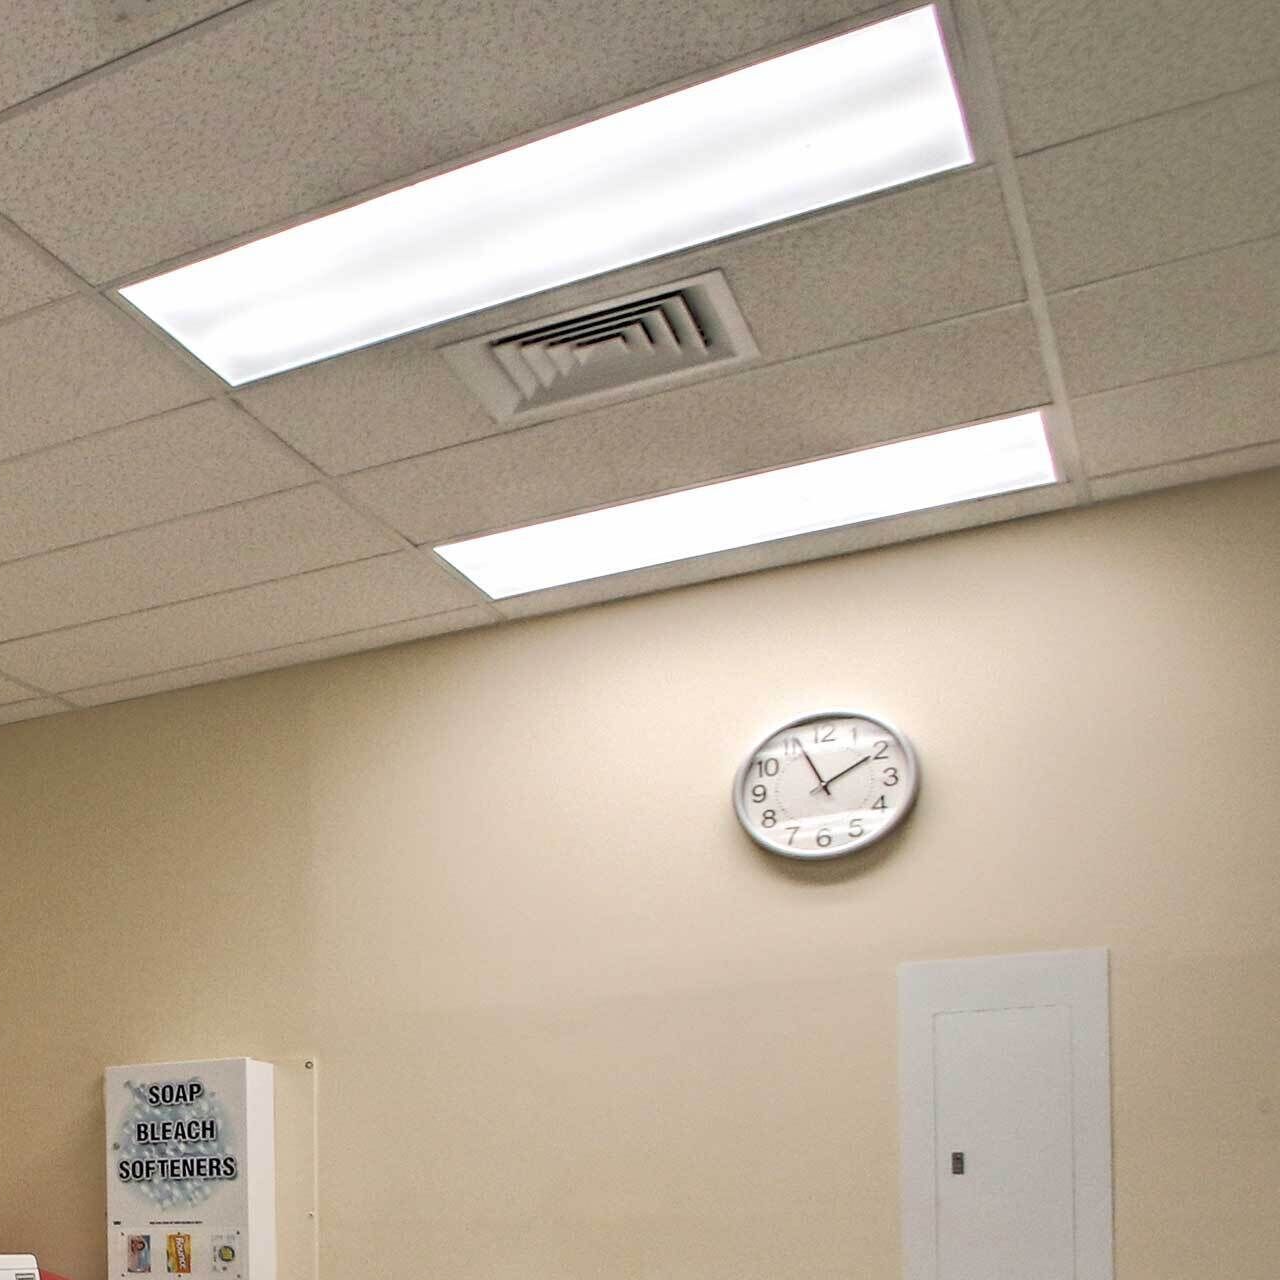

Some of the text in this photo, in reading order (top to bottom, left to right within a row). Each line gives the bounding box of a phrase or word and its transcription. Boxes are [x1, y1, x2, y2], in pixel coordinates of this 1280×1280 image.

[813, 725, 836, 744] 12
[783, 736, 802, 755] 11
[872, 740, 889, 760] 2
[756, 757, 780, 778] 10
[882, 767, 899, 787] 3
[751, 783, 767, 804] 9
[871, 794, 888, 814] 4
[761, 808, 777, 829] 8
[847, 818, 865, 838] 5
[785, 826, 800, 846] 7
[816, 827, 832, 848] 6
[149, 1084, 202, 1104] SOAP
[137, 1121, 215, 1142] BLEACH
[119, 1157, 236, 1179] SOFTENERS
